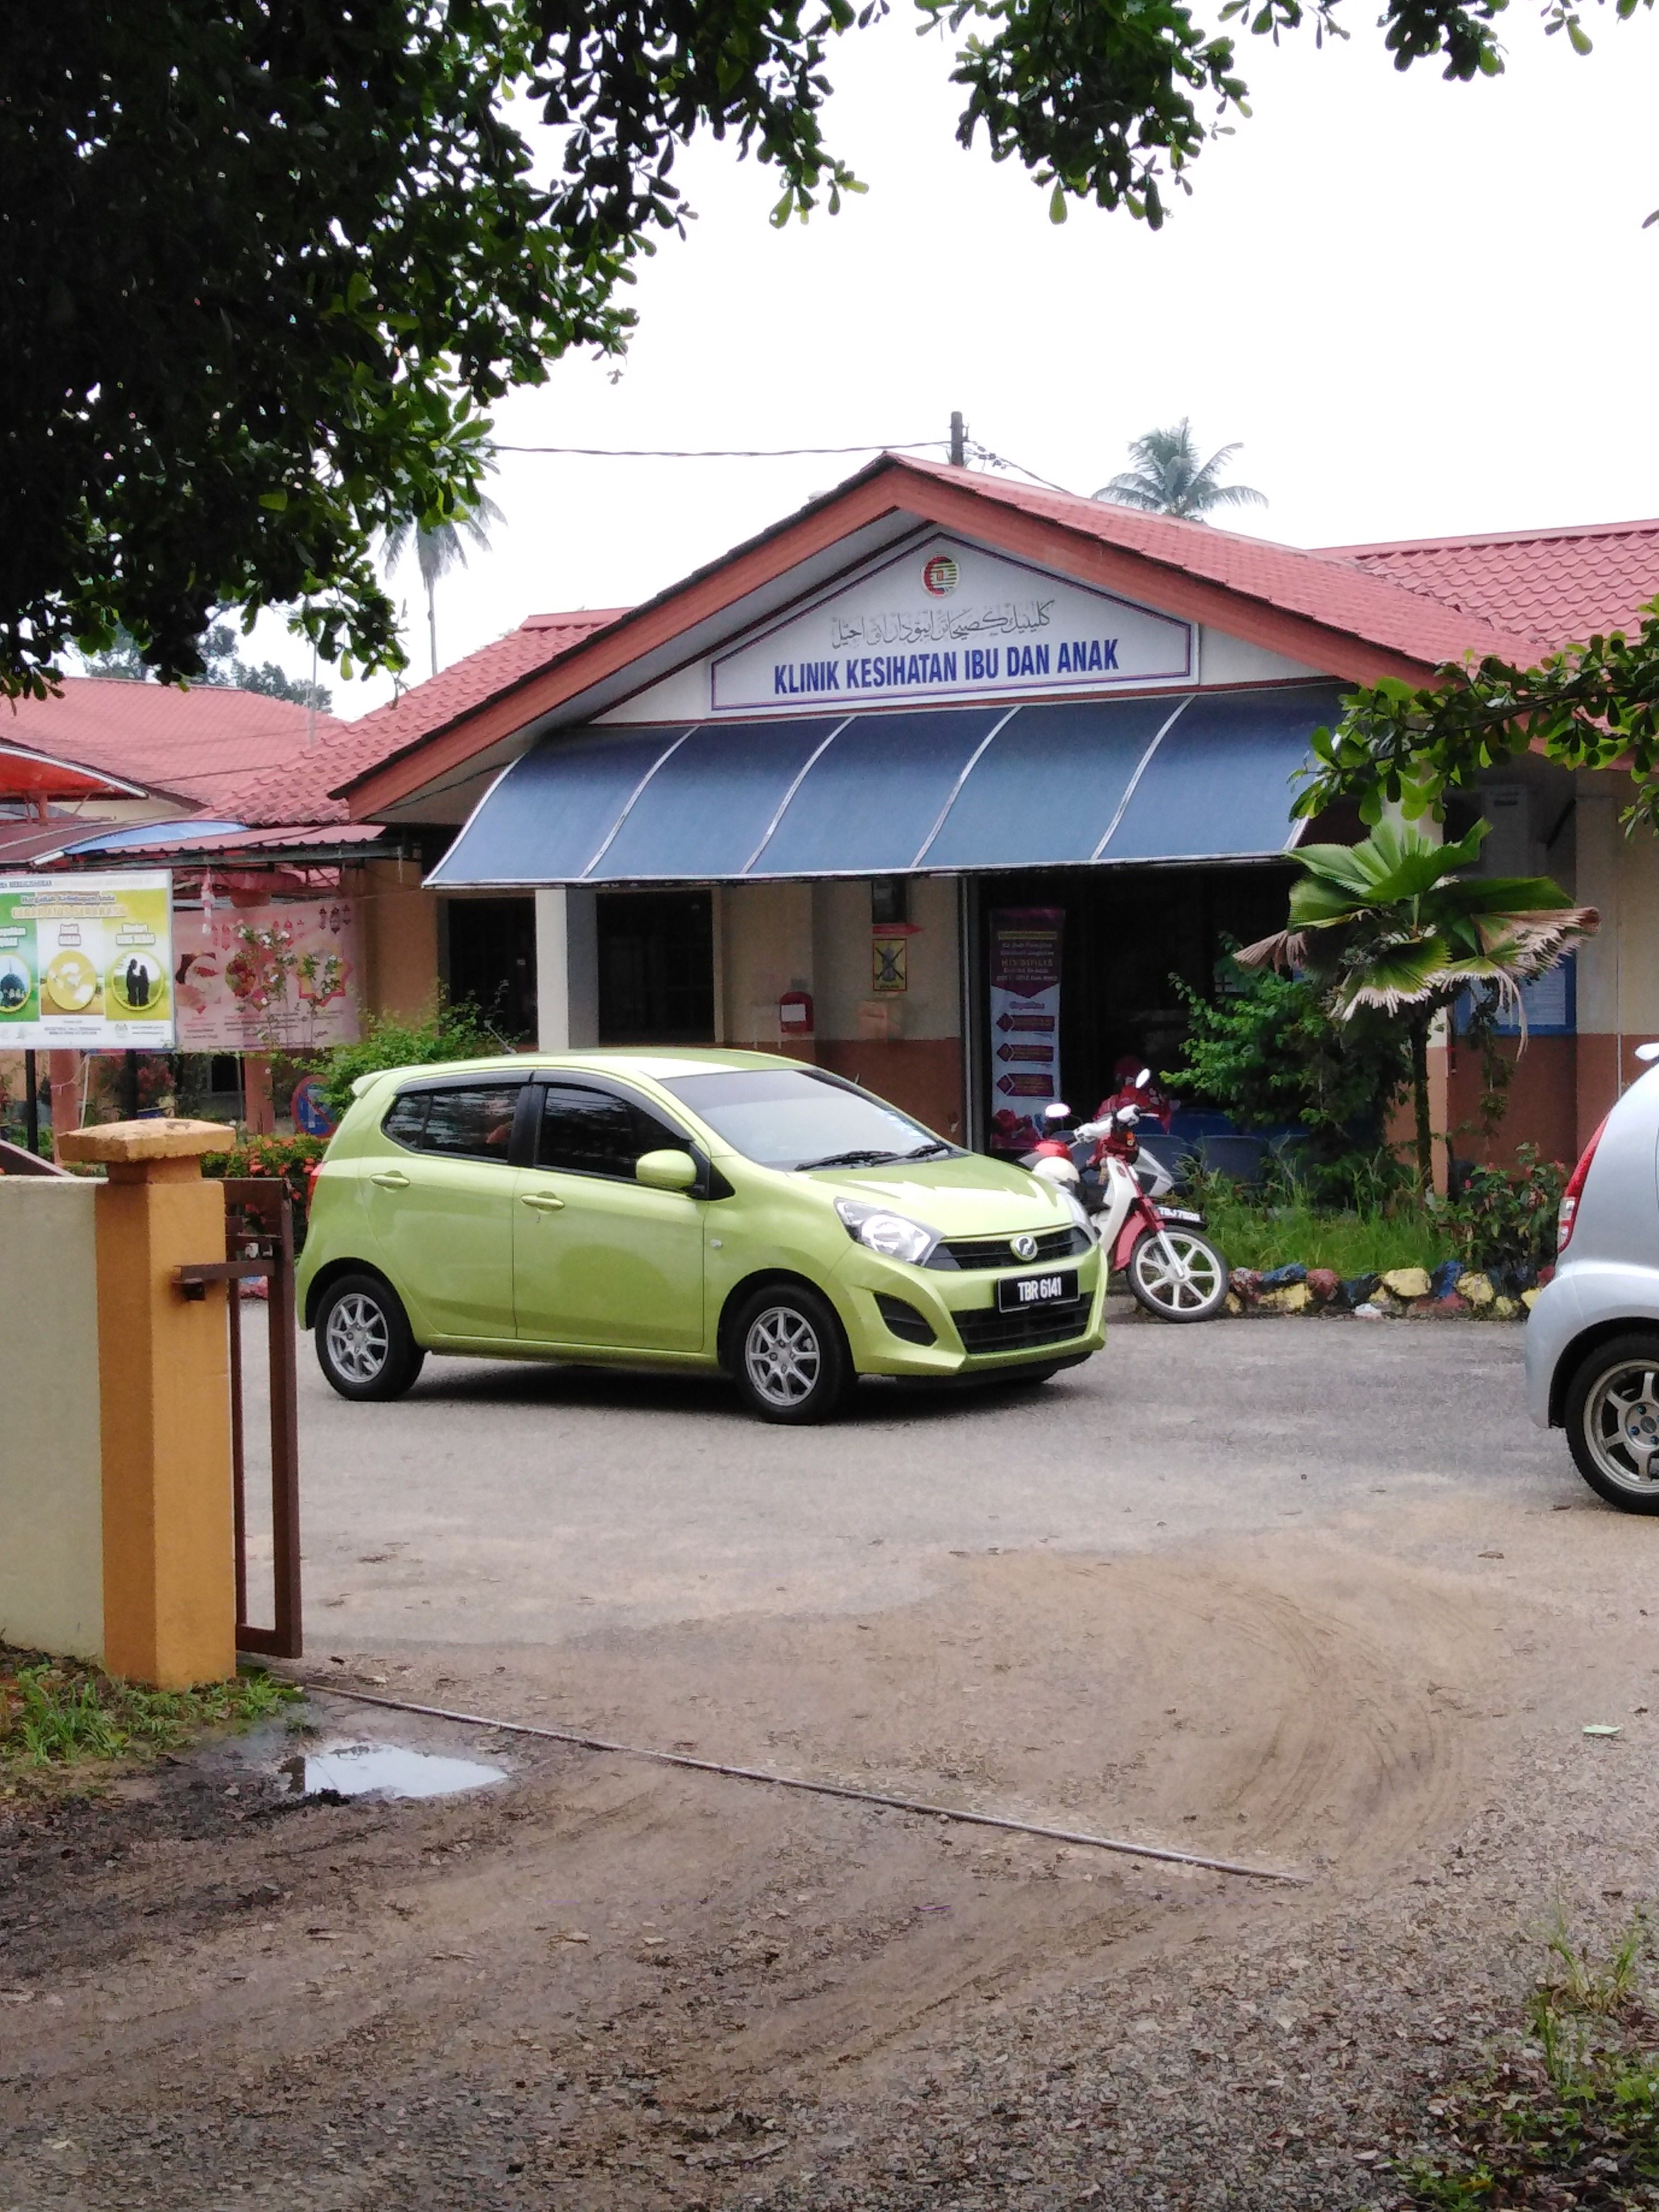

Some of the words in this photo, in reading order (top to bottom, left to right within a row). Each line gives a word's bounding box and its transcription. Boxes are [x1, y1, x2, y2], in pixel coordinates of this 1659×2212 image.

[774, 660, 840, 694] KLINIK
[846, 651, 957, 689] KESIHATAN
[964, 647, 999, 680] IBU
[1007, 643, 1050, 677] DAN
[1057, 639, 1119, 674] ANAK
[1017, 1280, 1039, 1302] TBR
[1040, 1276, 1062, 1298] 6141
